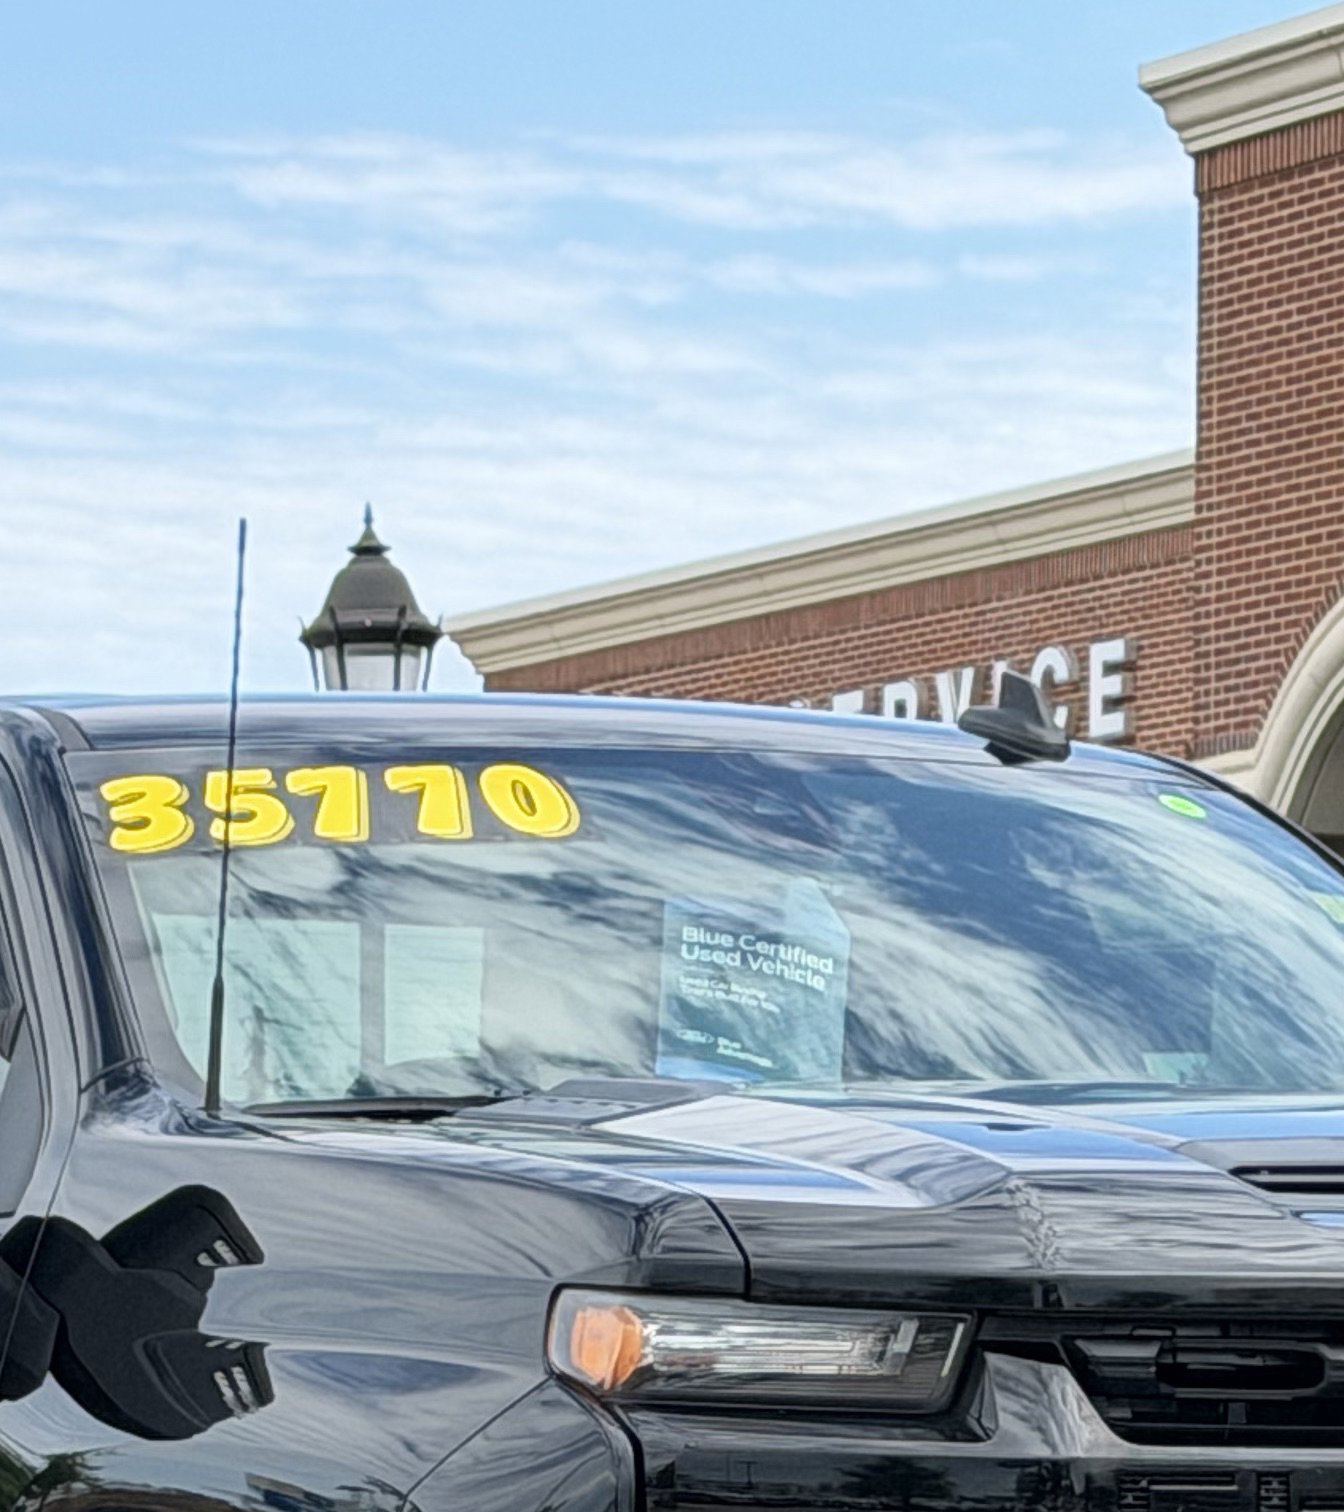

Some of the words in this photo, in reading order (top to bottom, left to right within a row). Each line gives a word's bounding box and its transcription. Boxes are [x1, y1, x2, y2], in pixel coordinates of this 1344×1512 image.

[100, 764, 580, 853] 35770
[681, 943, 741, 967] Used
[747, 953, 826, 992] Vehicle
[682, 926, 734, 948] Blue
[739, 934, 834, 975] Certified
